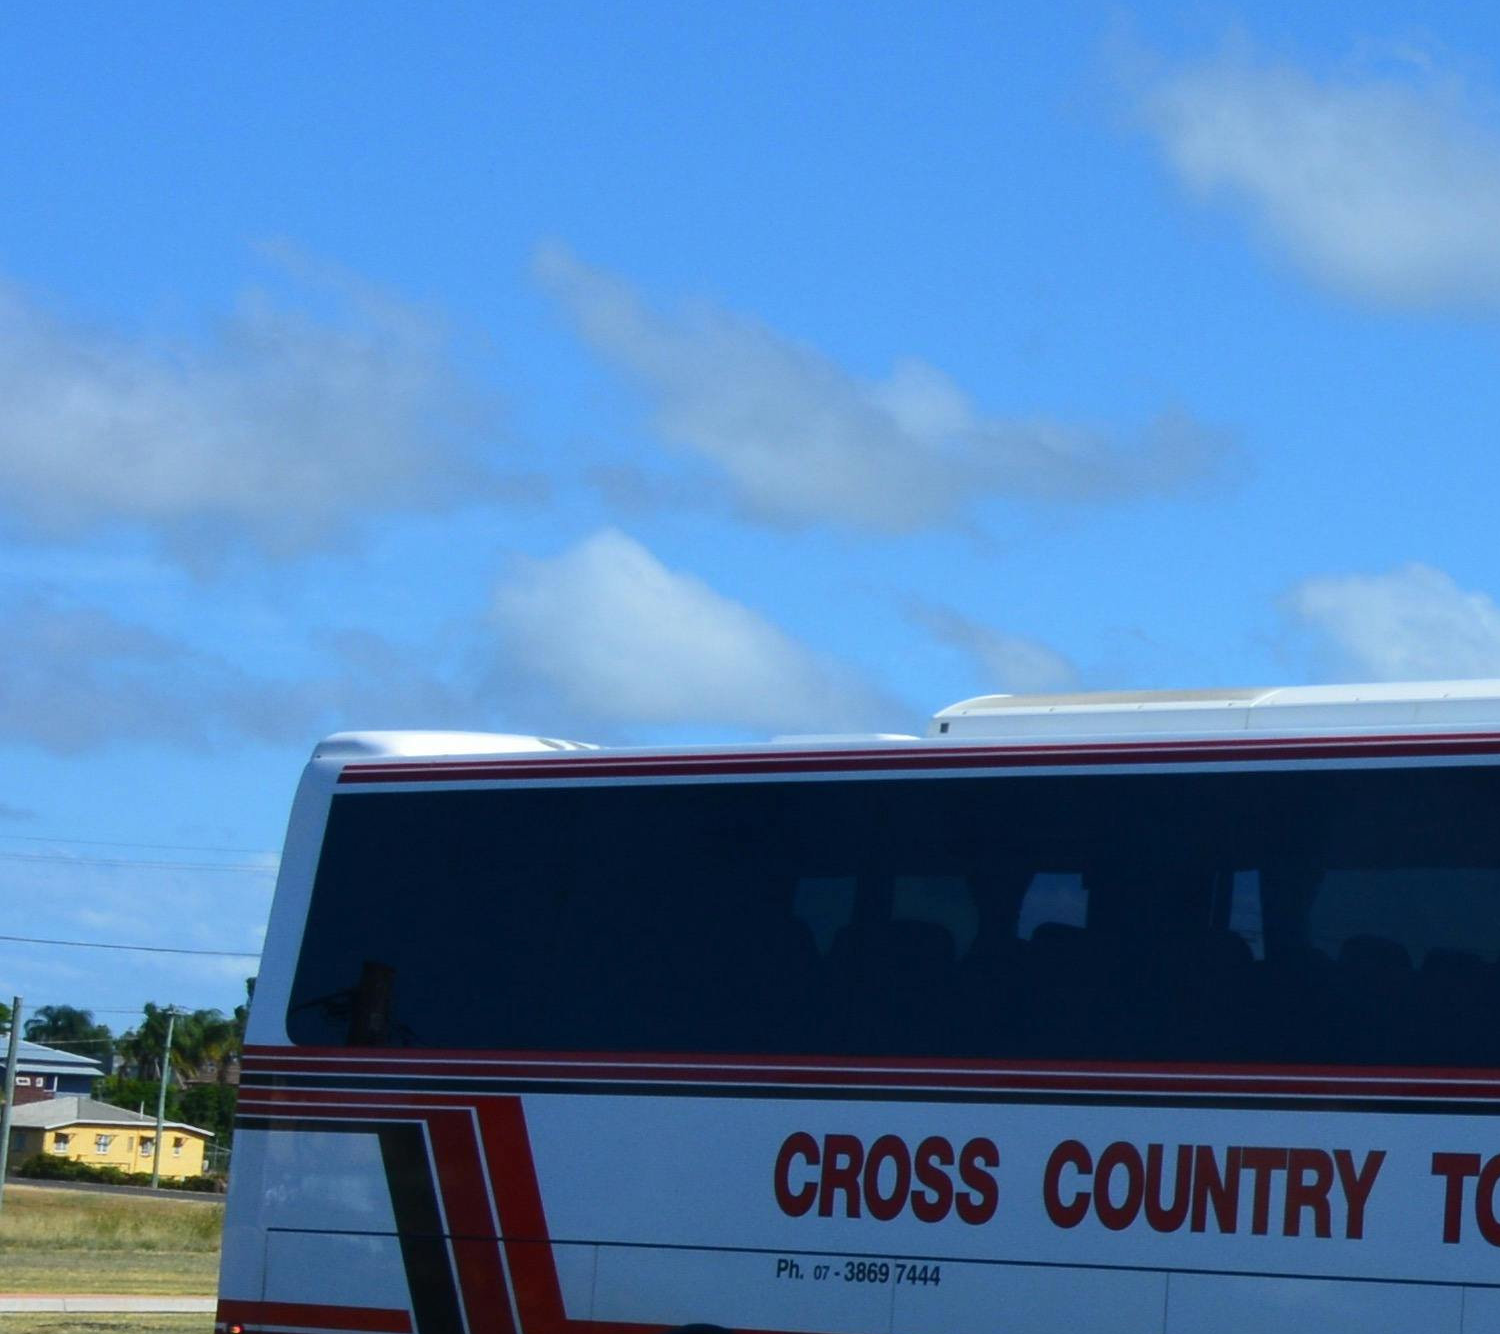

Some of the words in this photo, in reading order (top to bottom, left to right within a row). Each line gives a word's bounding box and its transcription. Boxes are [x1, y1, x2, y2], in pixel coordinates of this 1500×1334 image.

[774, 1131, 999, 1226] CROSS
[1043, 1139, 1387, 1241] COUNTRY
[776, 1257, 804, 1281] Ph.
[813, 1264, 830, 1282] 07
[844, 1261, 890, 1285] 3869
[895, 1263, 941, 1287] 7444
